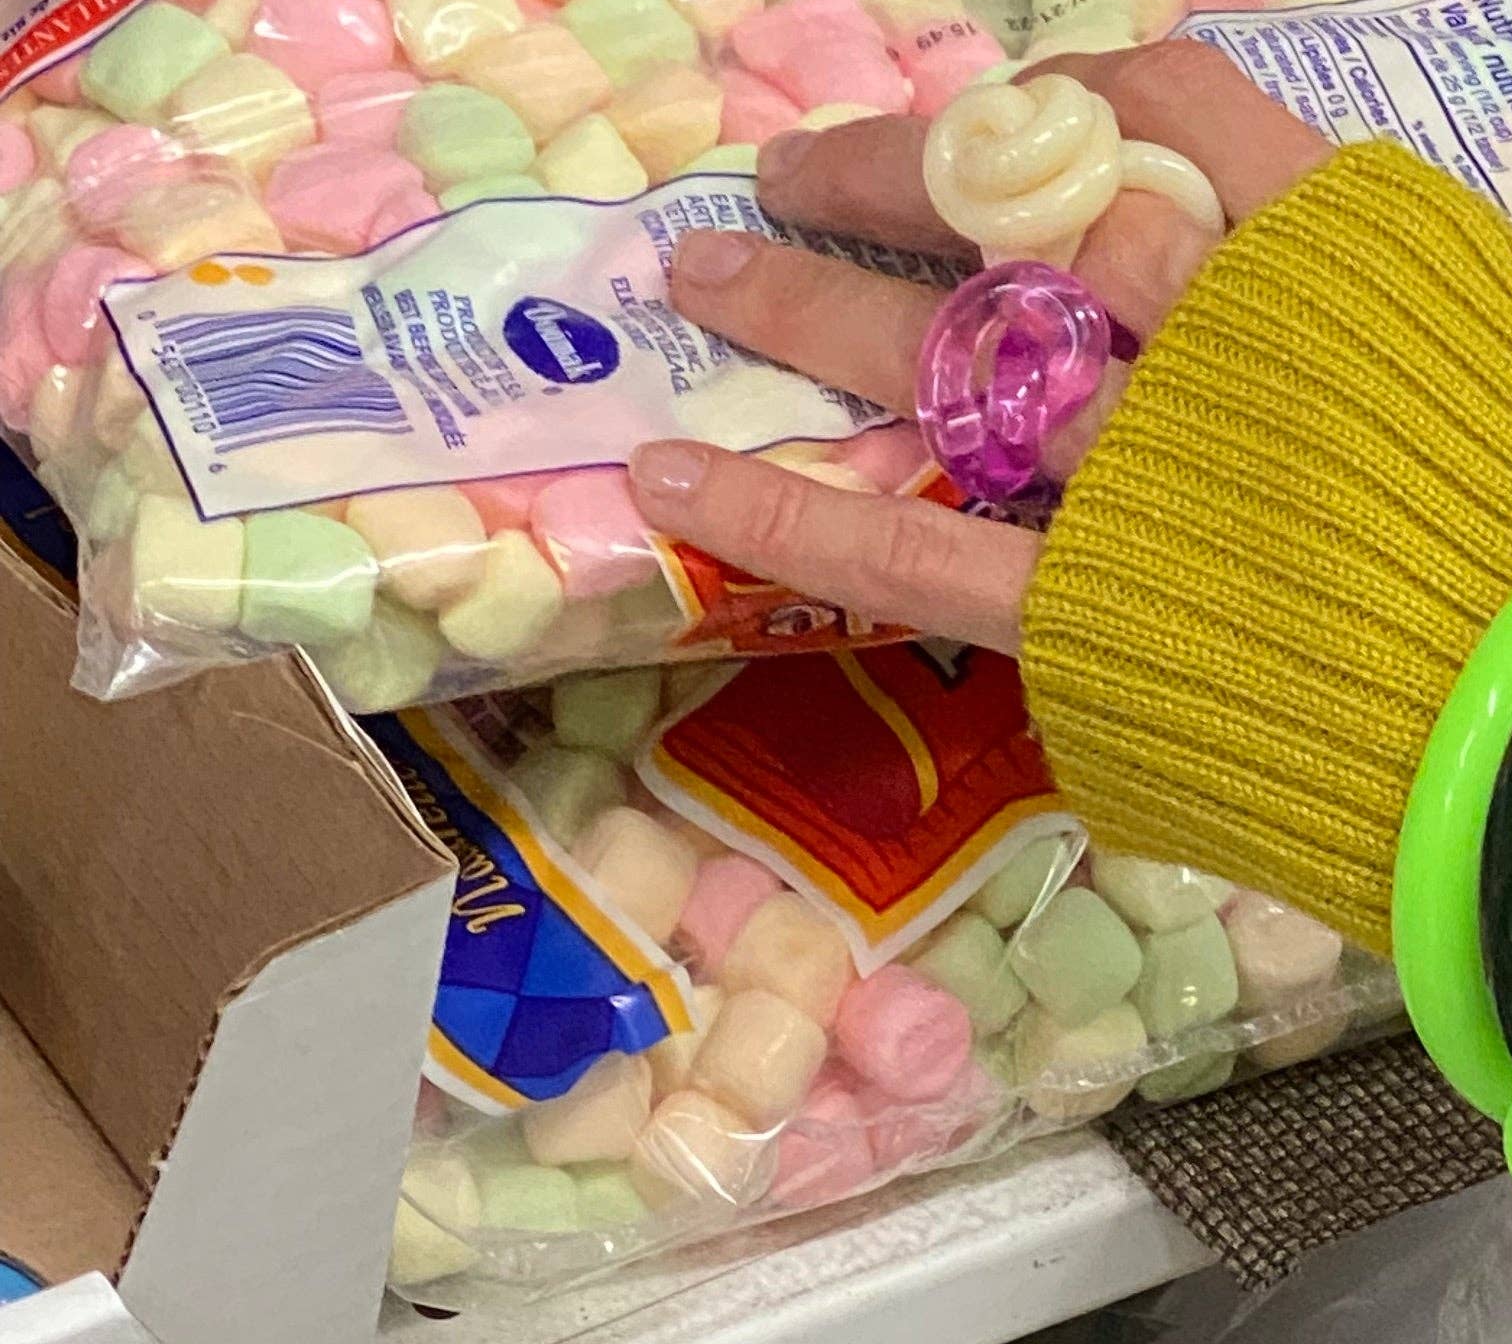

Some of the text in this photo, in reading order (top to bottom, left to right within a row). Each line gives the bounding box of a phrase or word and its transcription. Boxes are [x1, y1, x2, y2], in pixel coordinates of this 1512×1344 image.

[1297, 32, 1350, 119] Lipides 0 g
[1429, 53, 1456, 75] de
[1444, 37, 1486, 89] serving
[1467, 86, 1501, 117] (1/2
[1348, 63, 1392, 126] Calories
[1440, 71, 1467, 96] 25
[1446, 93, 1468, 107] g
[1452, 105, 1488, 137] (1/2
